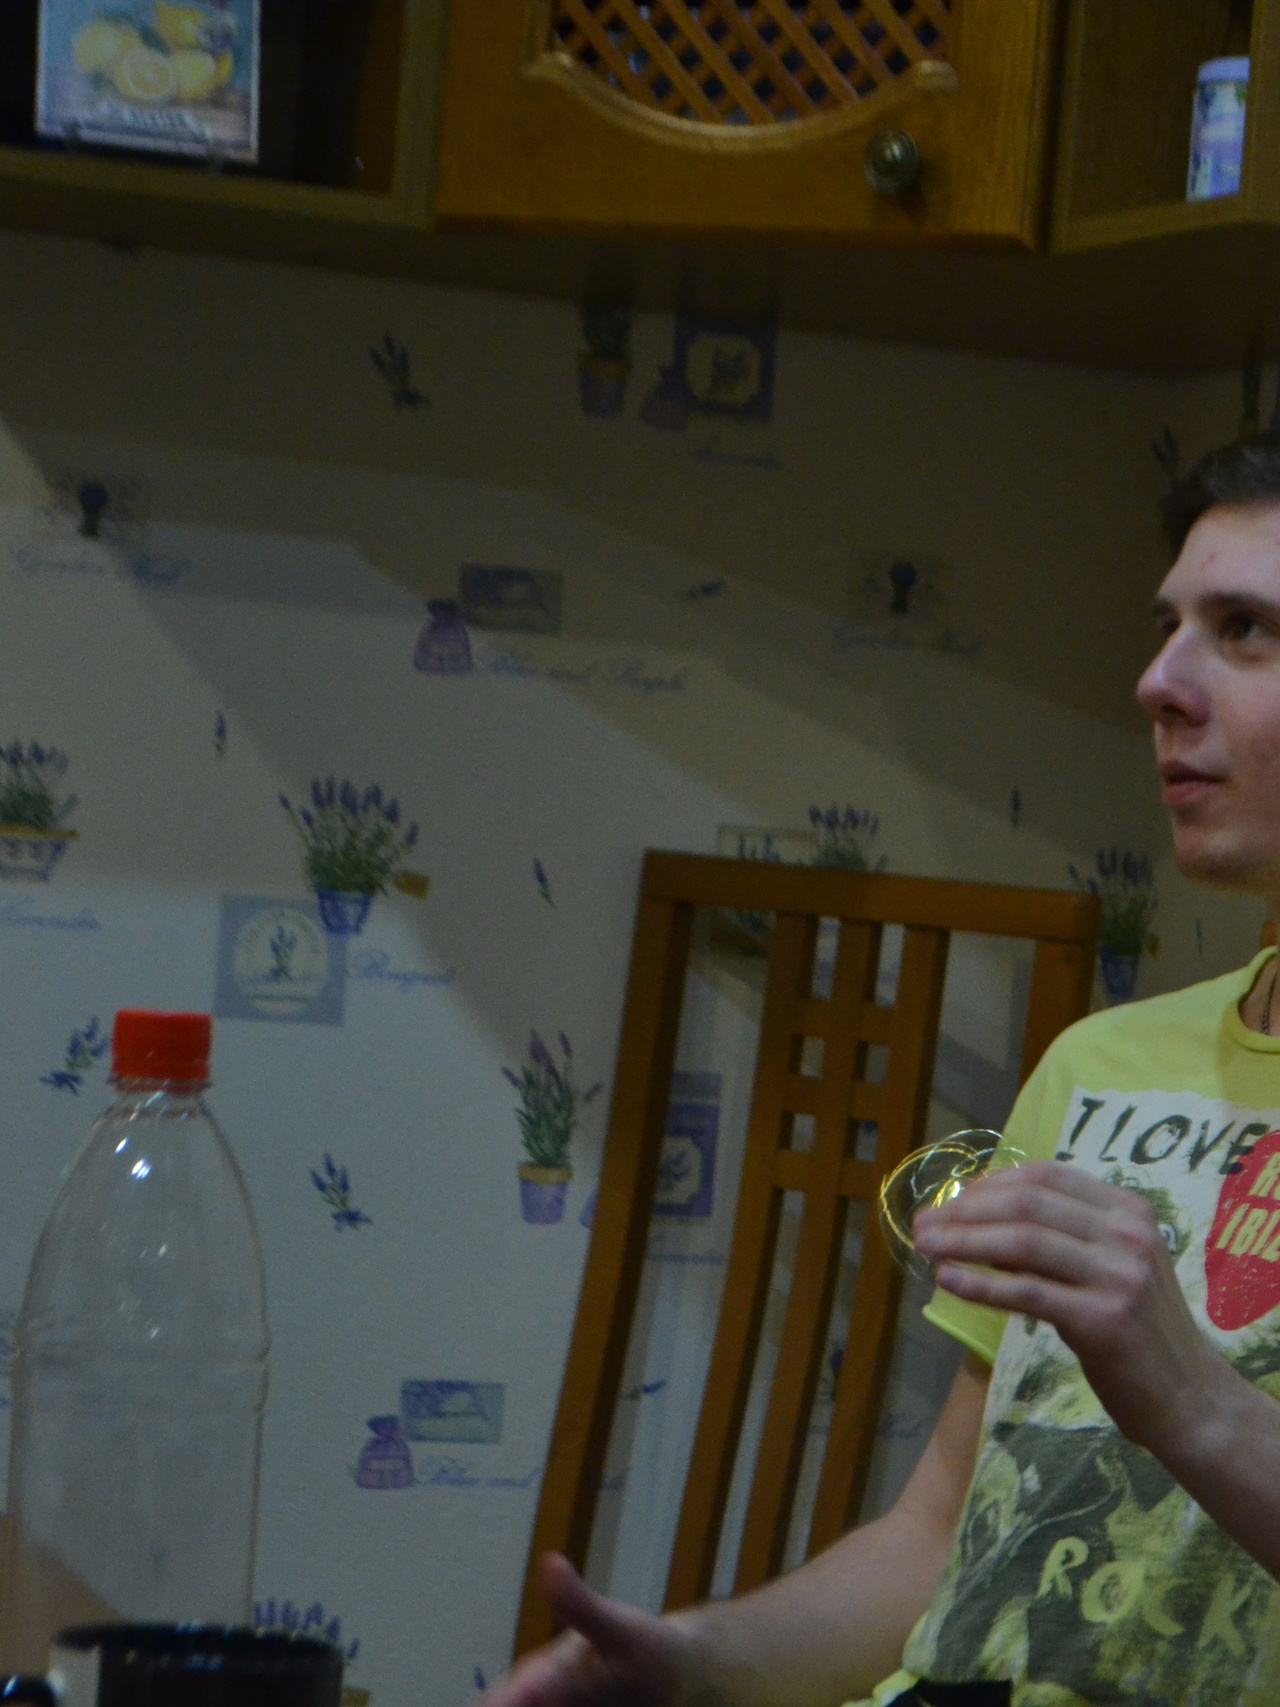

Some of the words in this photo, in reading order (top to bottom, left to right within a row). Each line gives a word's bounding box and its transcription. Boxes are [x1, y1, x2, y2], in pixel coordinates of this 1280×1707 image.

[1056, 1098, 1103, 1162] I
[1100, 1105, 1270, 1175] LOVE
[1037, 1536, 1251, 1655] ROCK
